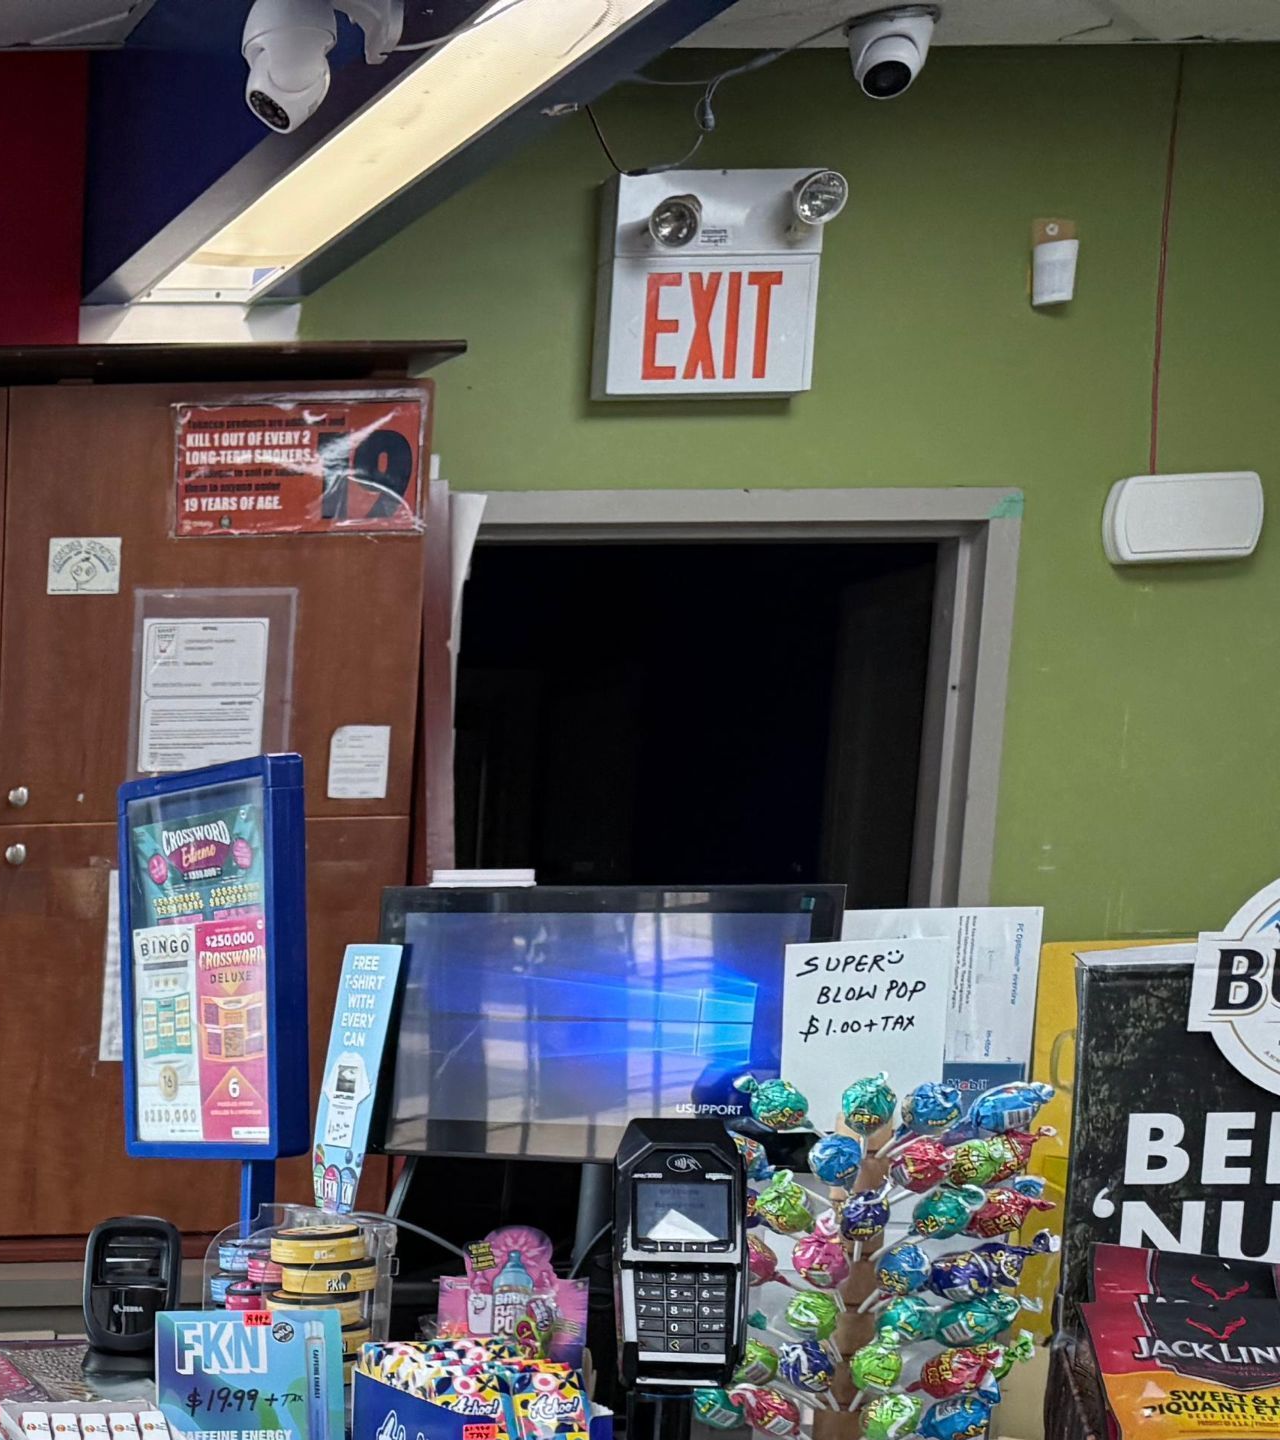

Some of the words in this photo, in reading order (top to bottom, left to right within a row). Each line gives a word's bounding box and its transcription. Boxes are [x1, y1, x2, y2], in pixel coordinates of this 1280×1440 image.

[641, 271, 783, 380] EXIT
[186, 432, 211, 448] KILL
[214, 432, 219, 447] 1
[221, 432, 245, 447] OUT
[248, 432, 262, 446] OF
[264, 431, 299, 446] EVERY
[302, 431, 311, 445] 2
[162, 819, 231, 855] CROSSWORD
[140, 935, 190, 958] BINGO
[205, 931, 255, 947] $250,000
[199, 944, 263, 972] CROSSWORD
[353, 955, 379, 971] FREE
[796, 954, 885, 977] SUPER
[210, 972, 252, 985] DELUXE
[345, 975, 385, 990] T-SHIRT
[817, 985, 877, 1004] BLOW
[885, 980, 926, 1001] POP
[348, 994, 375, 1009] WITH
[341, 1013, 375, 1028] EVERY
[343, 1032, 365, 1046] CAN
[175, 1321, 268, 1375] FKN
[1170, 1391, 1247, 1402] SWEET
